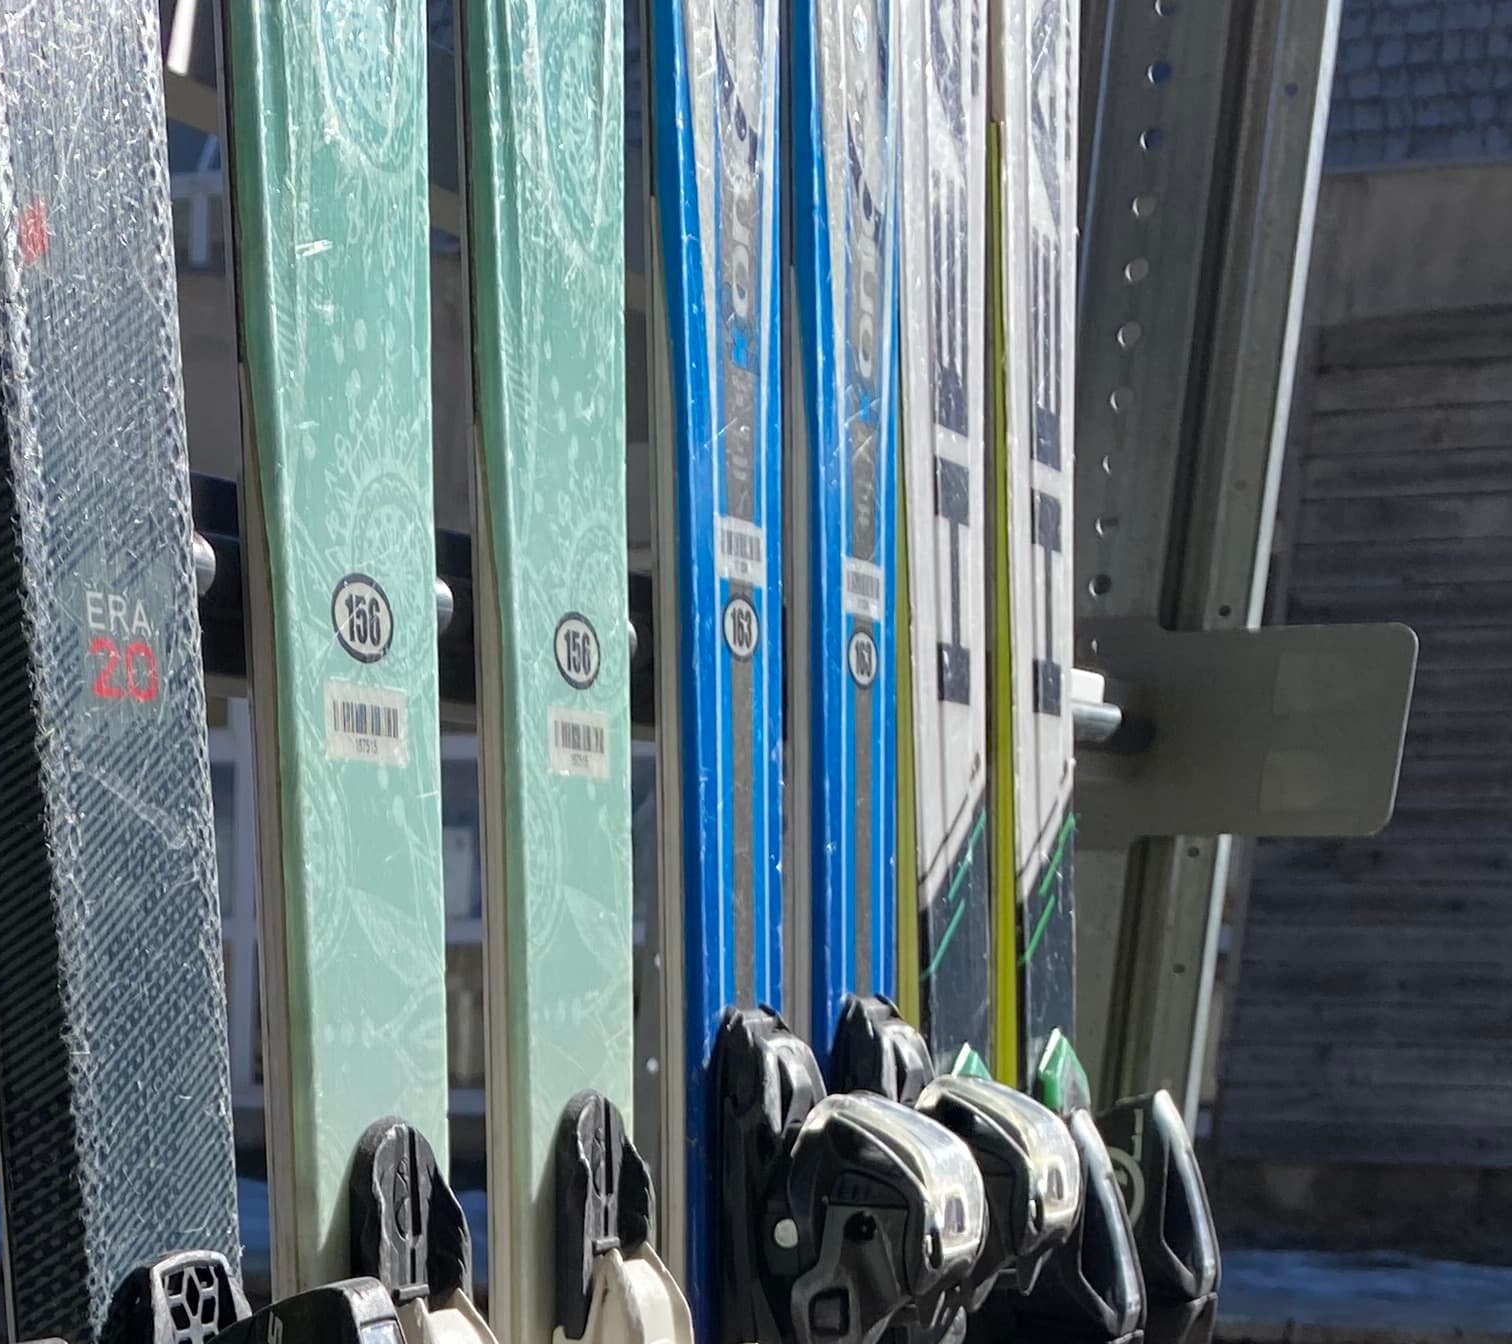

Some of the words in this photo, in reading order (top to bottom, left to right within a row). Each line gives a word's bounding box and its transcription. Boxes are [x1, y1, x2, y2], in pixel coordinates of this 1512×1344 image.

[86, 591, 152, 638] ERA
[345, 593, 381, 646] 156
[731, 607, 752, 649] 163
[563, 629, 591, 675] 156
[855, 641, 872, 677] 163
